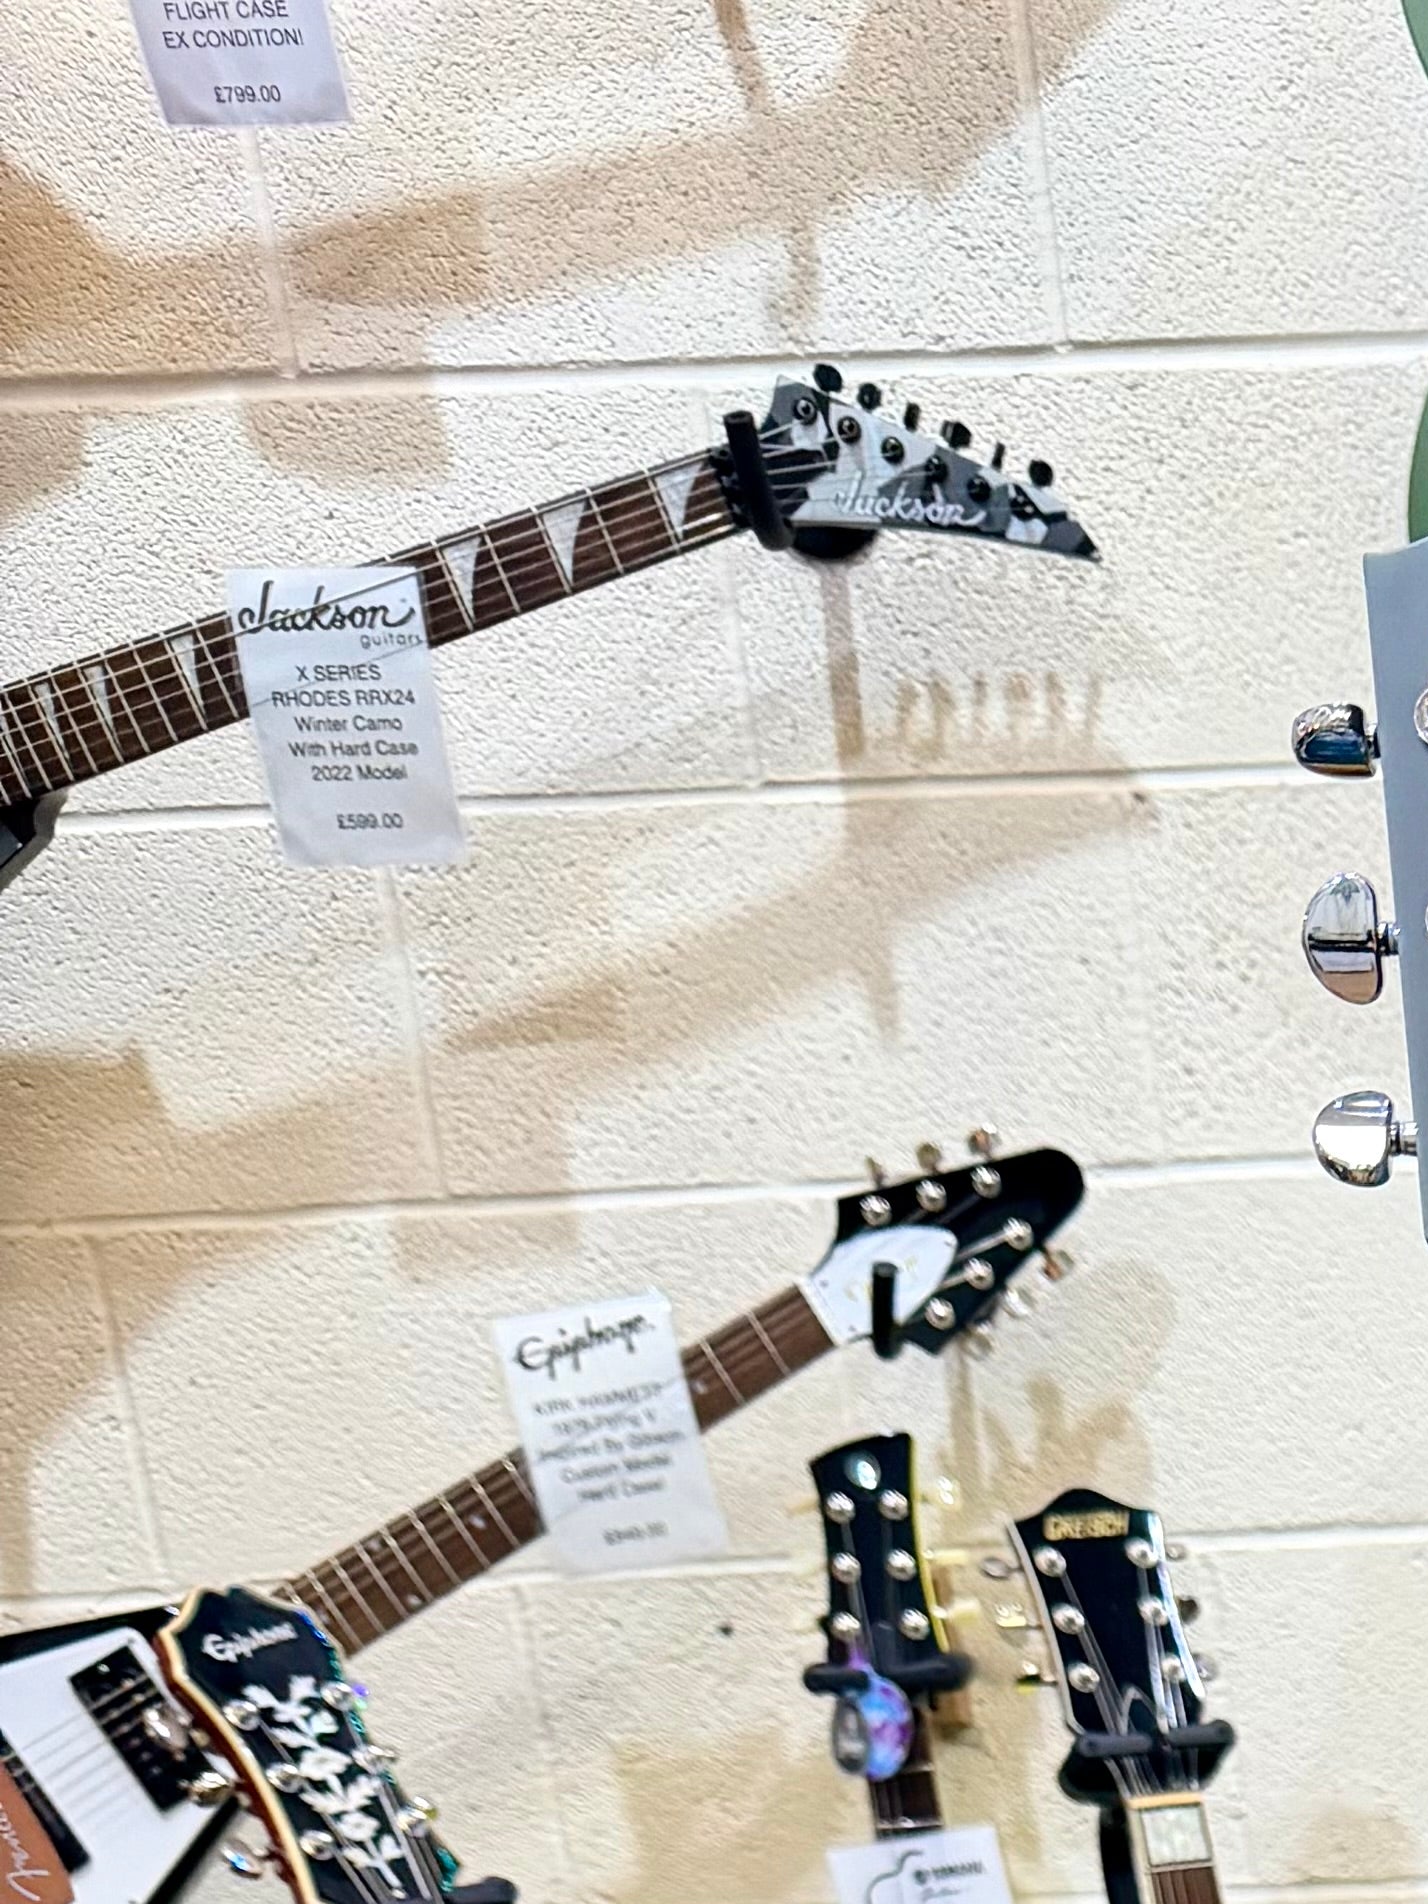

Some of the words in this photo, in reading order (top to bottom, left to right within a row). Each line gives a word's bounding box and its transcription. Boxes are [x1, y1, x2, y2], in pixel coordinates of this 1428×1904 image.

[163, 1, 231, 21] FLIGHT
[236, 0, 289, 19] CASE
[162, 31, 190, 50] EX
[192, 28, 304, 48] CONDITION!
[214, 85, 281, 104] £799.00
[238, 580, 415, 634] Jackson
[295, 665, 308, 682] X
[313, 664, 382, 682] SERIES
[271, 690, 351, 709] RHODES
[293, 715, 348, 733] Winter
[352, 714, 403, 732] Camo
[288, 741, 327, 758] With
[331, 740, 371, 757] Hard
[375, 739, 419, 756] Case
[357, 764, 408, 781] Model
